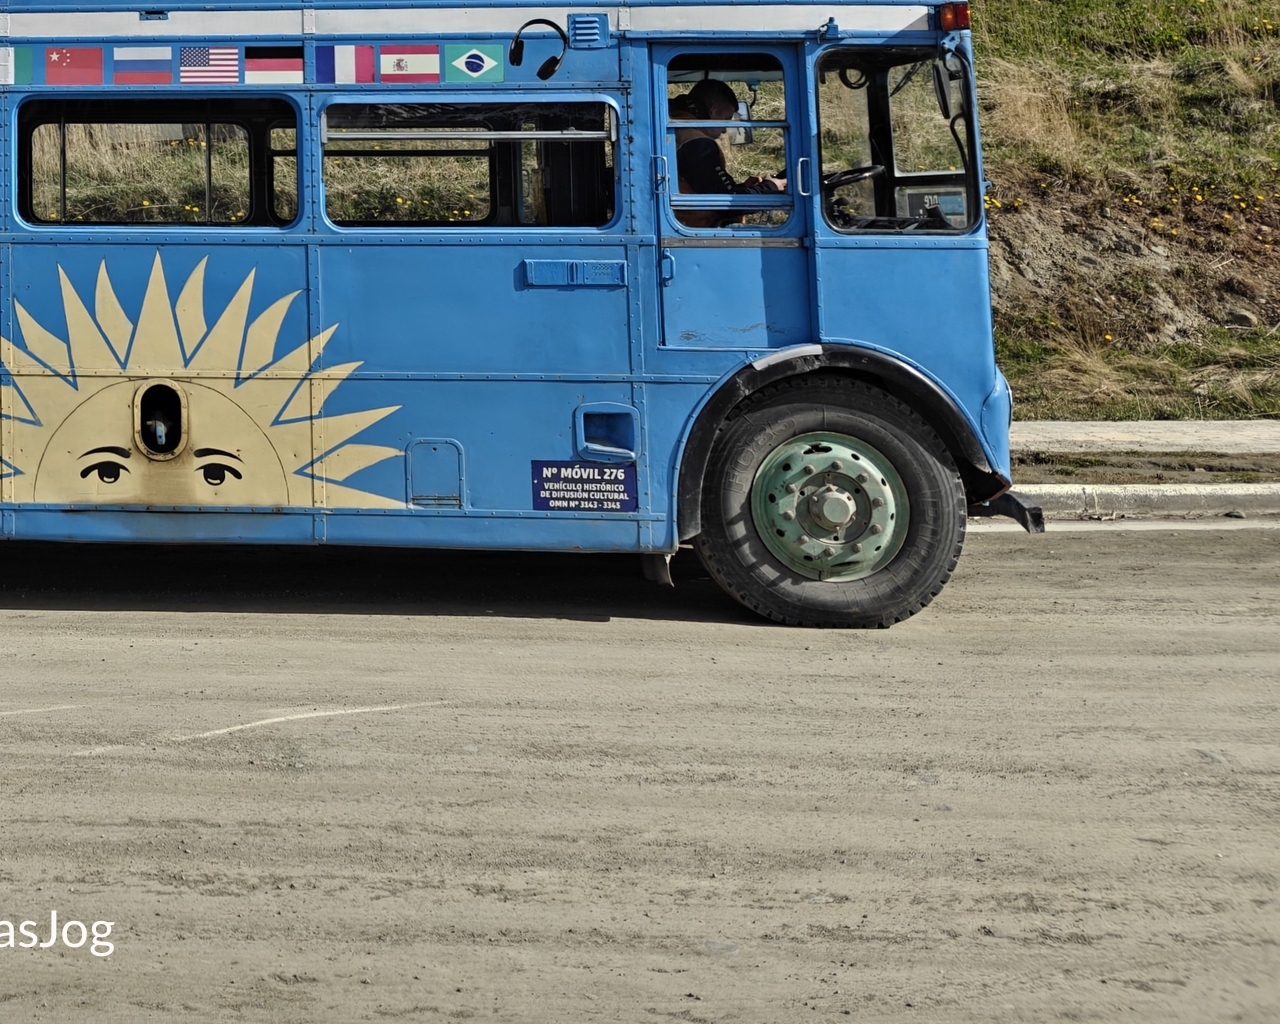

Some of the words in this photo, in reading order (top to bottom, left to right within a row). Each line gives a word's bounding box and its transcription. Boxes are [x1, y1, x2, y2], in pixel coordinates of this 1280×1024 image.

[560, 465, 601, 479] MÓVIL
[603, 469, 625, 480] 276
[544, 481, 582, 491] VEHÍCULO
[583, 482, 625, 491] HISTÓRICO
[552, 490, 588, 499] DIFUSIÓN
[589, 492, 629, 500] CULTURAL
